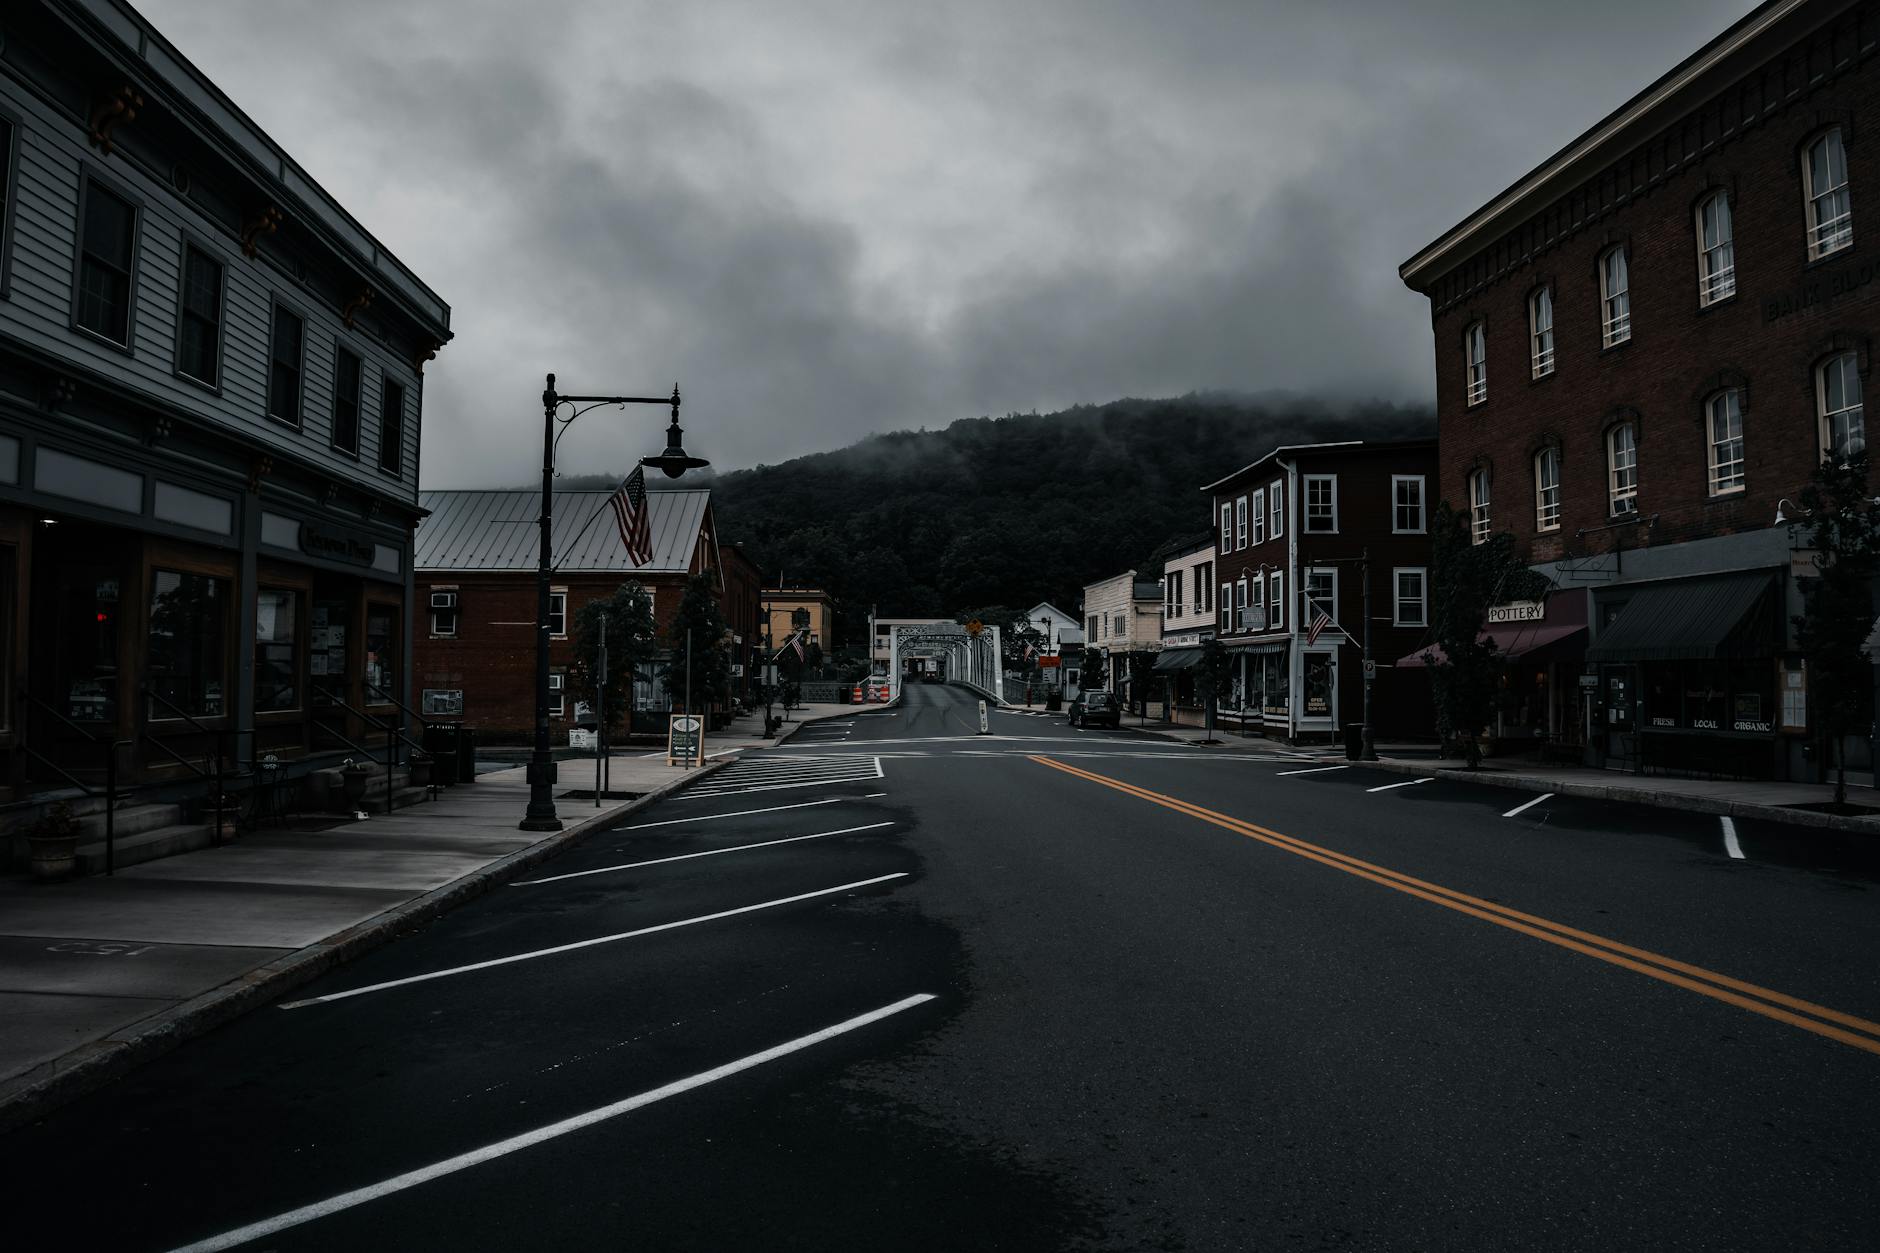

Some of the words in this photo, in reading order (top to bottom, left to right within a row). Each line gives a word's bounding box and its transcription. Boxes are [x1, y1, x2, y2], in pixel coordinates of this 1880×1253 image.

[1767, 283, 1822, 322] BANK
[1832, 261, 1880, 297] BLO
[1490, 605, 1542, 621] POTTERY
[1652, 717, 1675, 727] FRESH
[1693, 719, 1719, 729] LOCAL
[1733, 721, 1771, 732] ORGANIC
